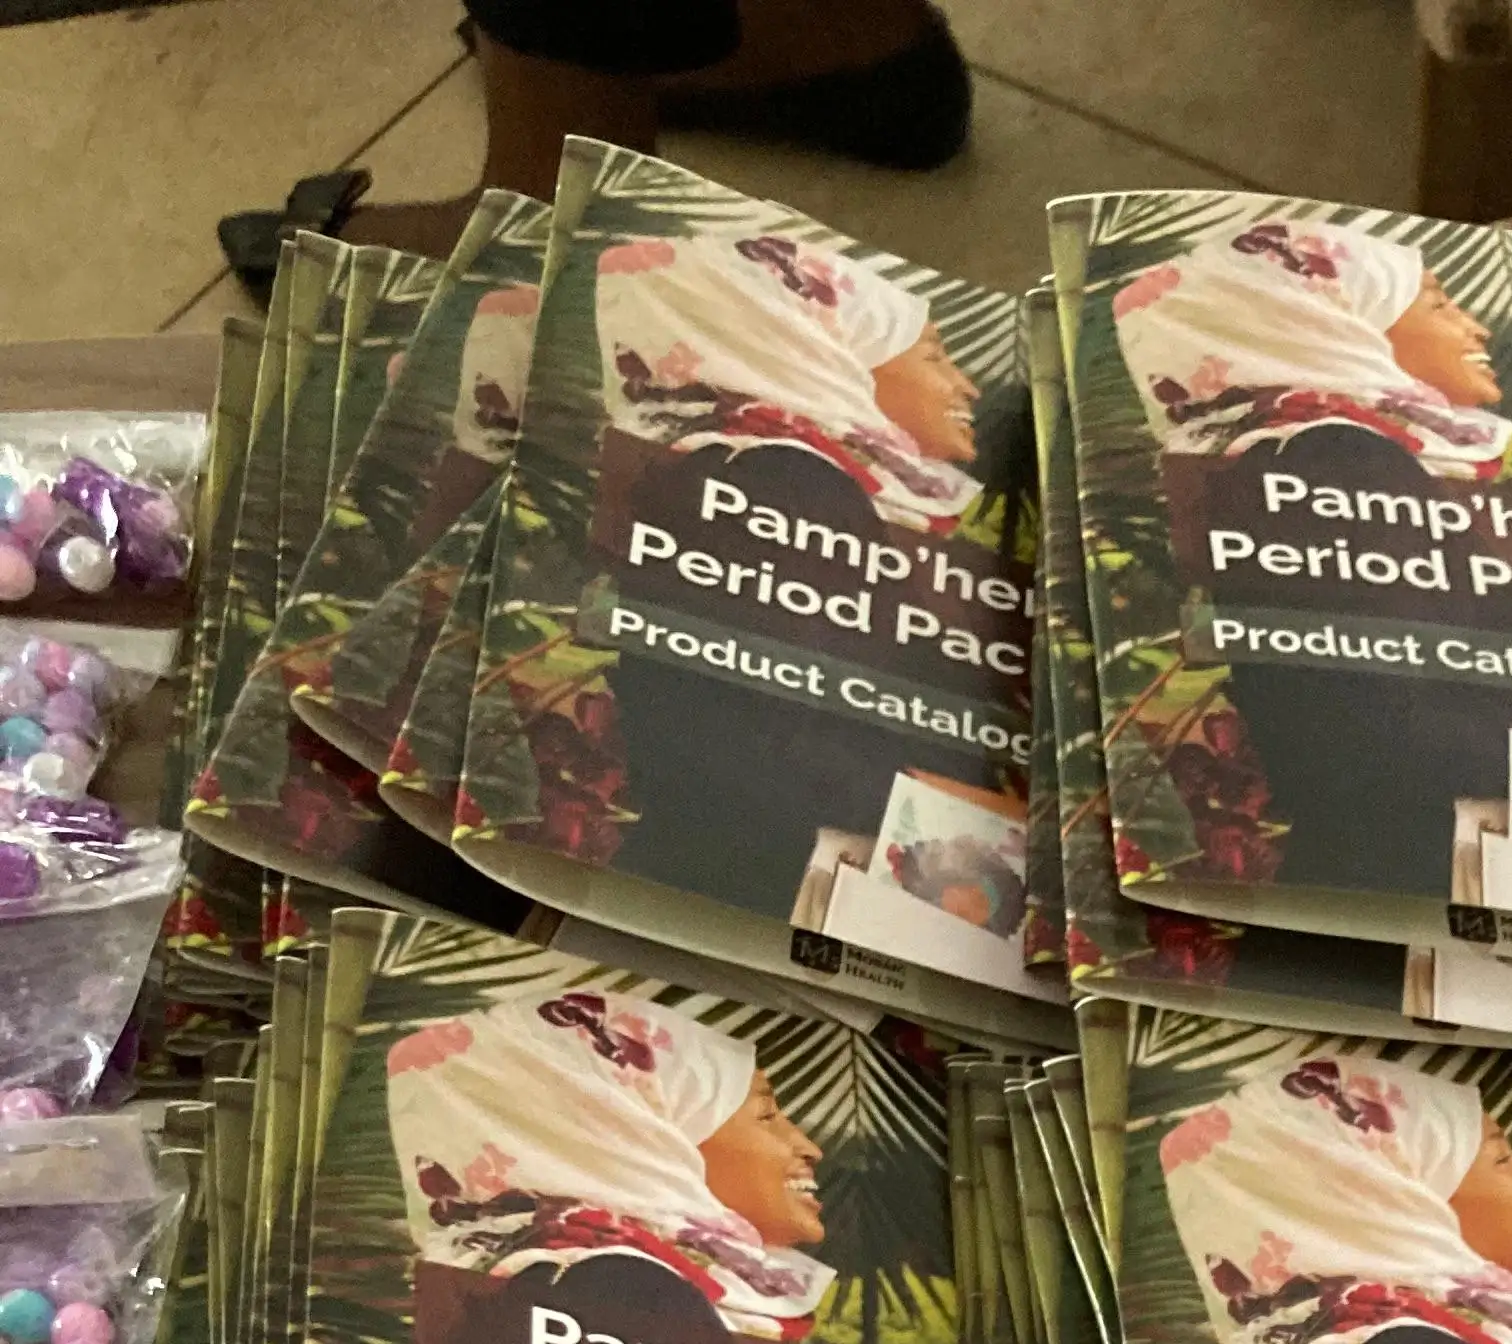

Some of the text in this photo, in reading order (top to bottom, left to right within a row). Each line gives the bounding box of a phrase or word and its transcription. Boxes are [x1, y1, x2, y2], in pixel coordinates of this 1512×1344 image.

[628, 522, 1025, 677] Period Pac
[1208, 530, 1450, 592] Period
[609, 607, 1031, 766] Product Catalog
[1211, 618, 1424, 667] Product
